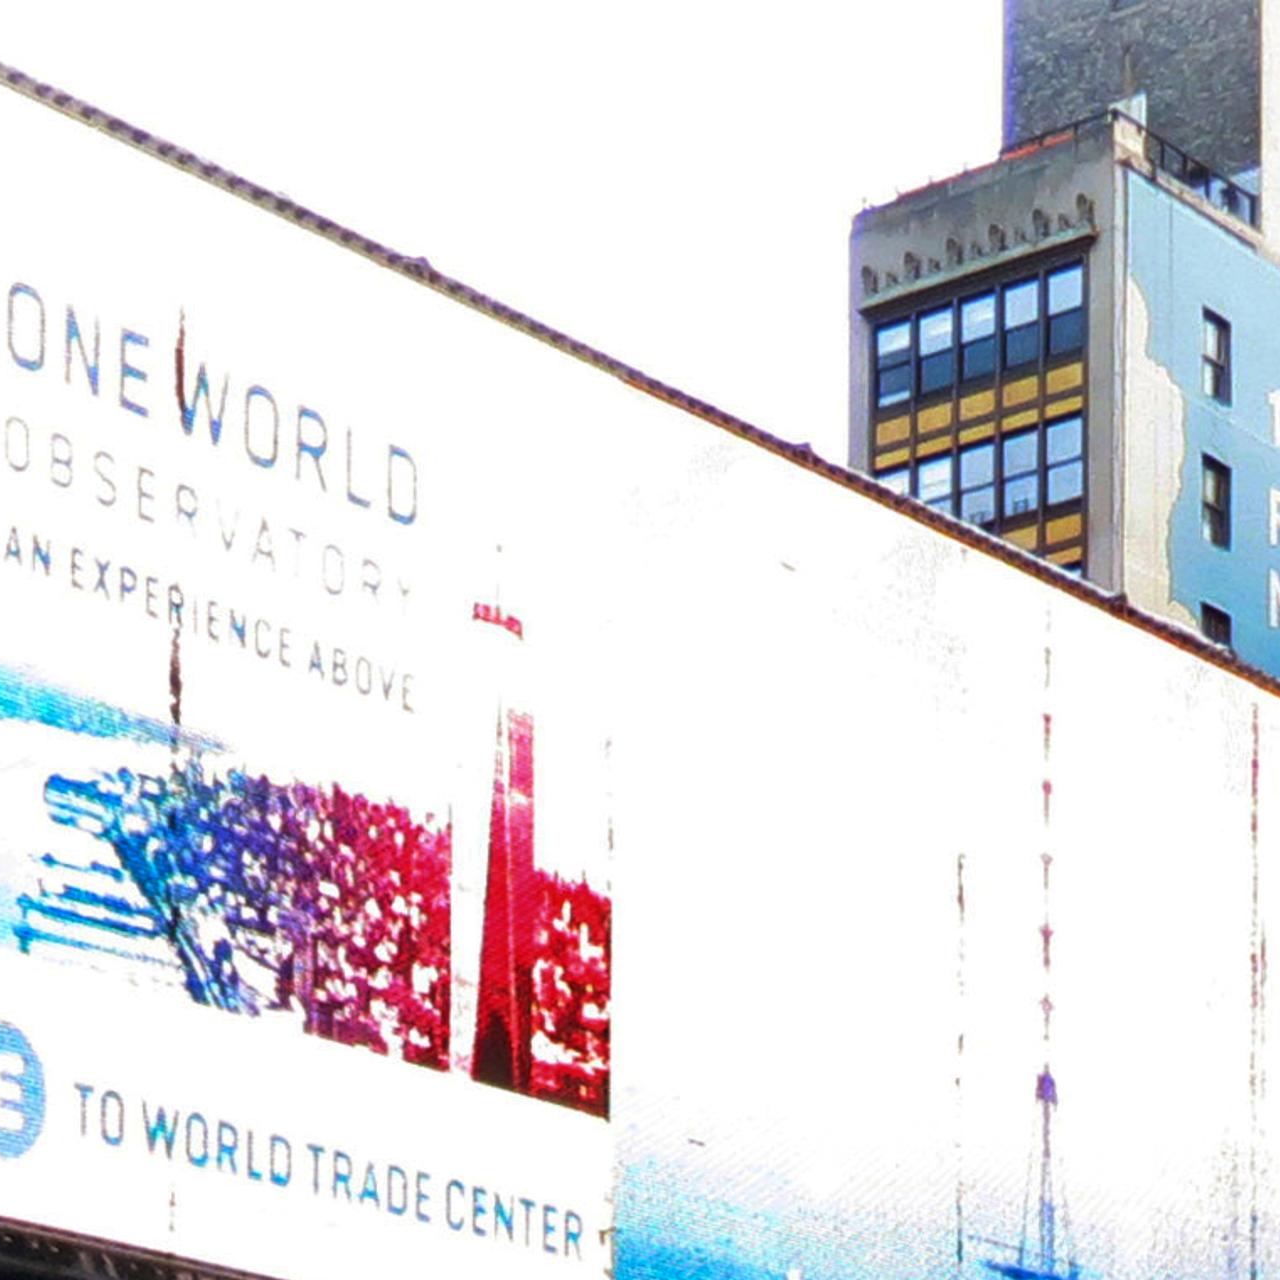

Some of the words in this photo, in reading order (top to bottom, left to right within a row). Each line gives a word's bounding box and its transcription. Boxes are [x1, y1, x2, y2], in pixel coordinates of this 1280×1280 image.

[6, 281, 150, 418] ONE
[174, 338, 420, 527] WORLD
[3, 415, 414, 617] OBSERVATORY
[3, 525, 52, 577] AN
[70, 548, 293, 669] EXPERIENCE
[307, 637, 417, 714] ABOVE
[75, 1082, 125, 1147] TO
[142, 1098, 293, 1187] WORLD
[307, 1144, 431, 1223] TRADE
[445, 1180, 585, 1262] CENTER
